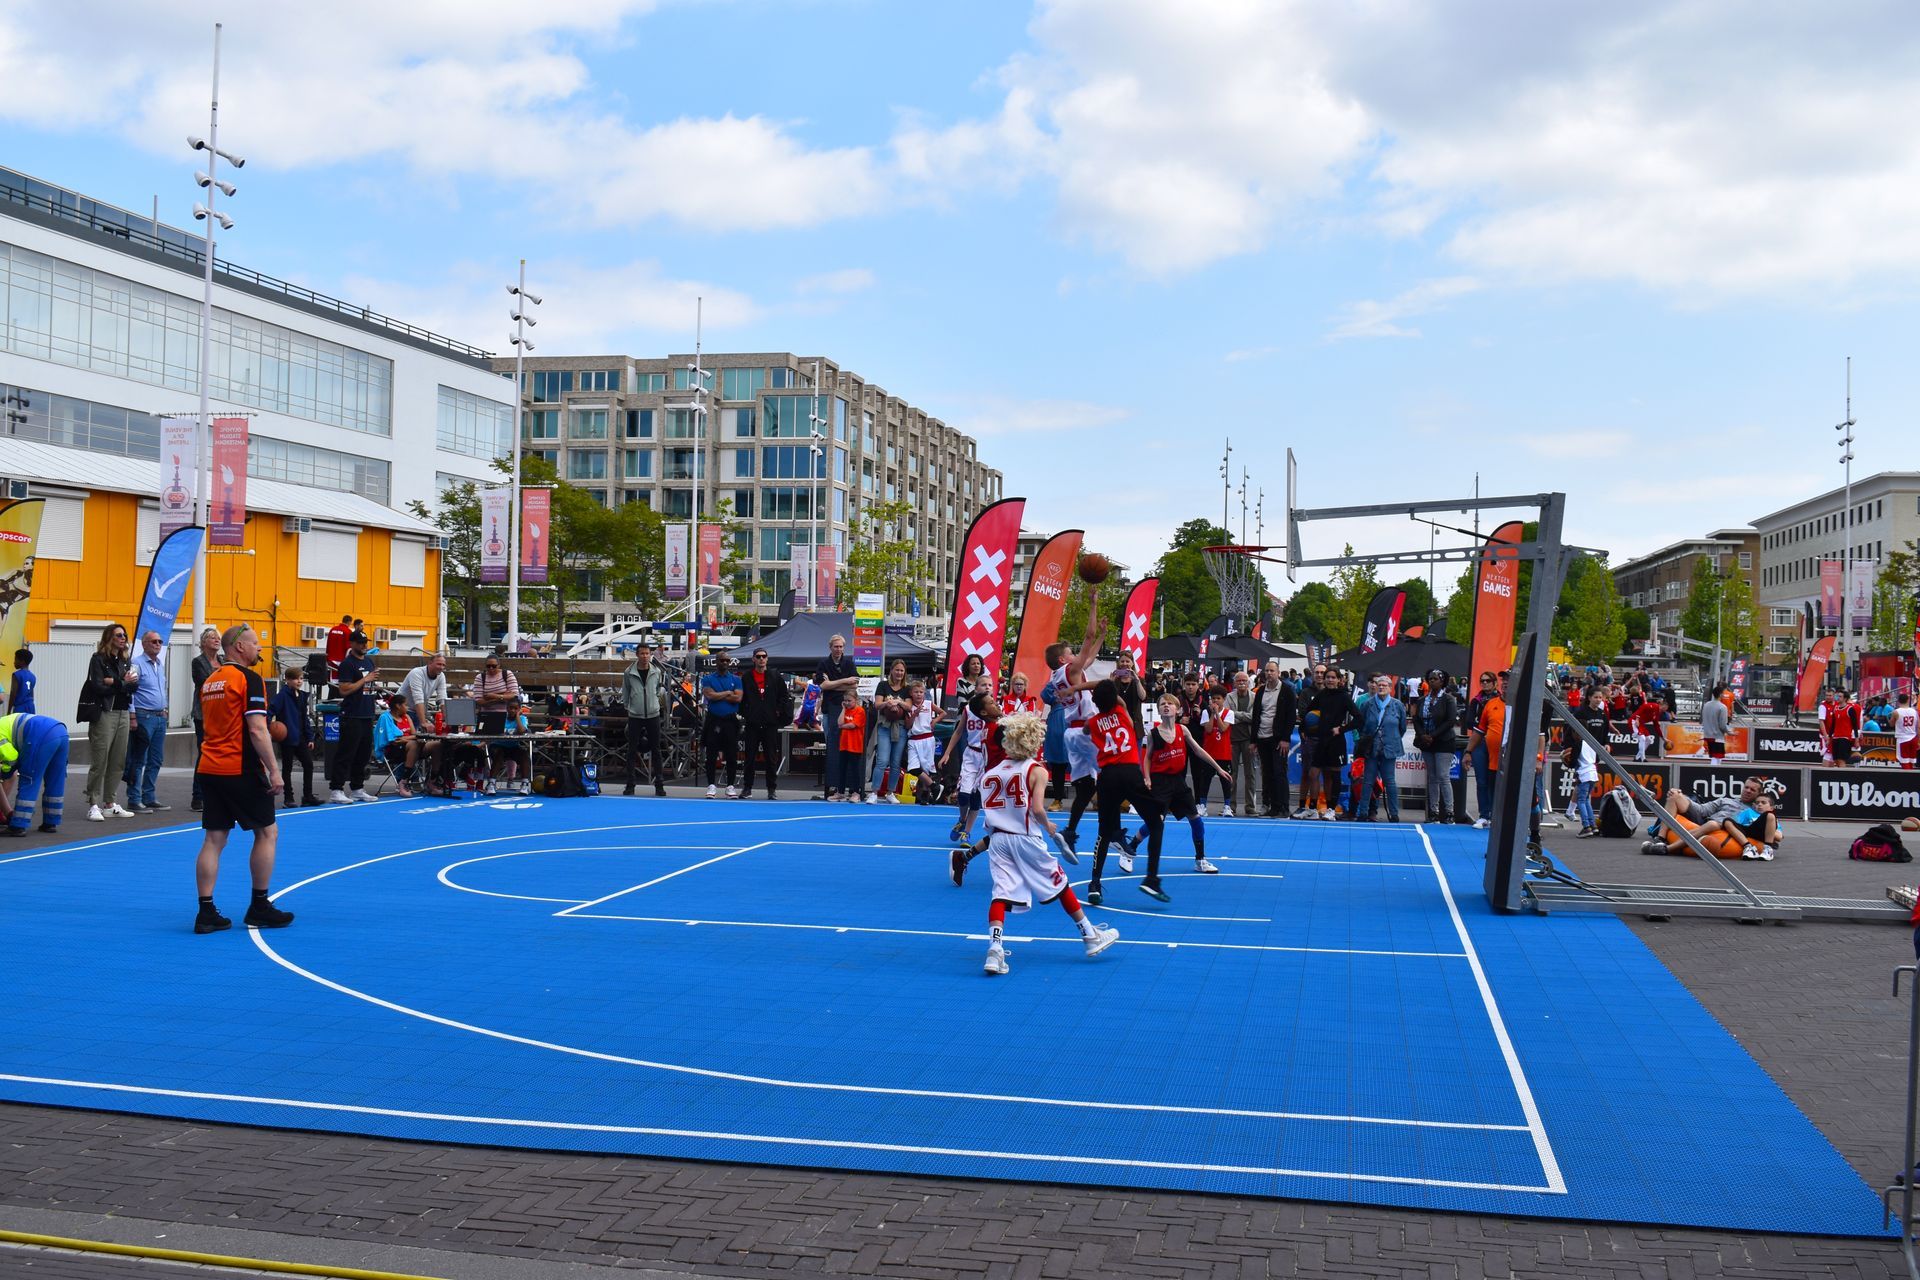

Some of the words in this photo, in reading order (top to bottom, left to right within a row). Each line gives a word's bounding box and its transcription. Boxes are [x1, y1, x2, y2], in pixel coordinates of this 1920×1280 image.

[1034, 580, 1062, 601] GAMES
[1483, 580, 1511, 598] GAMES
[967, 719, 984, 731] 83
[1103, 727, 1132, 755] 42
[983, 773, 1027, 809] 24
[1819, 781, 1920, 808] Wilson
